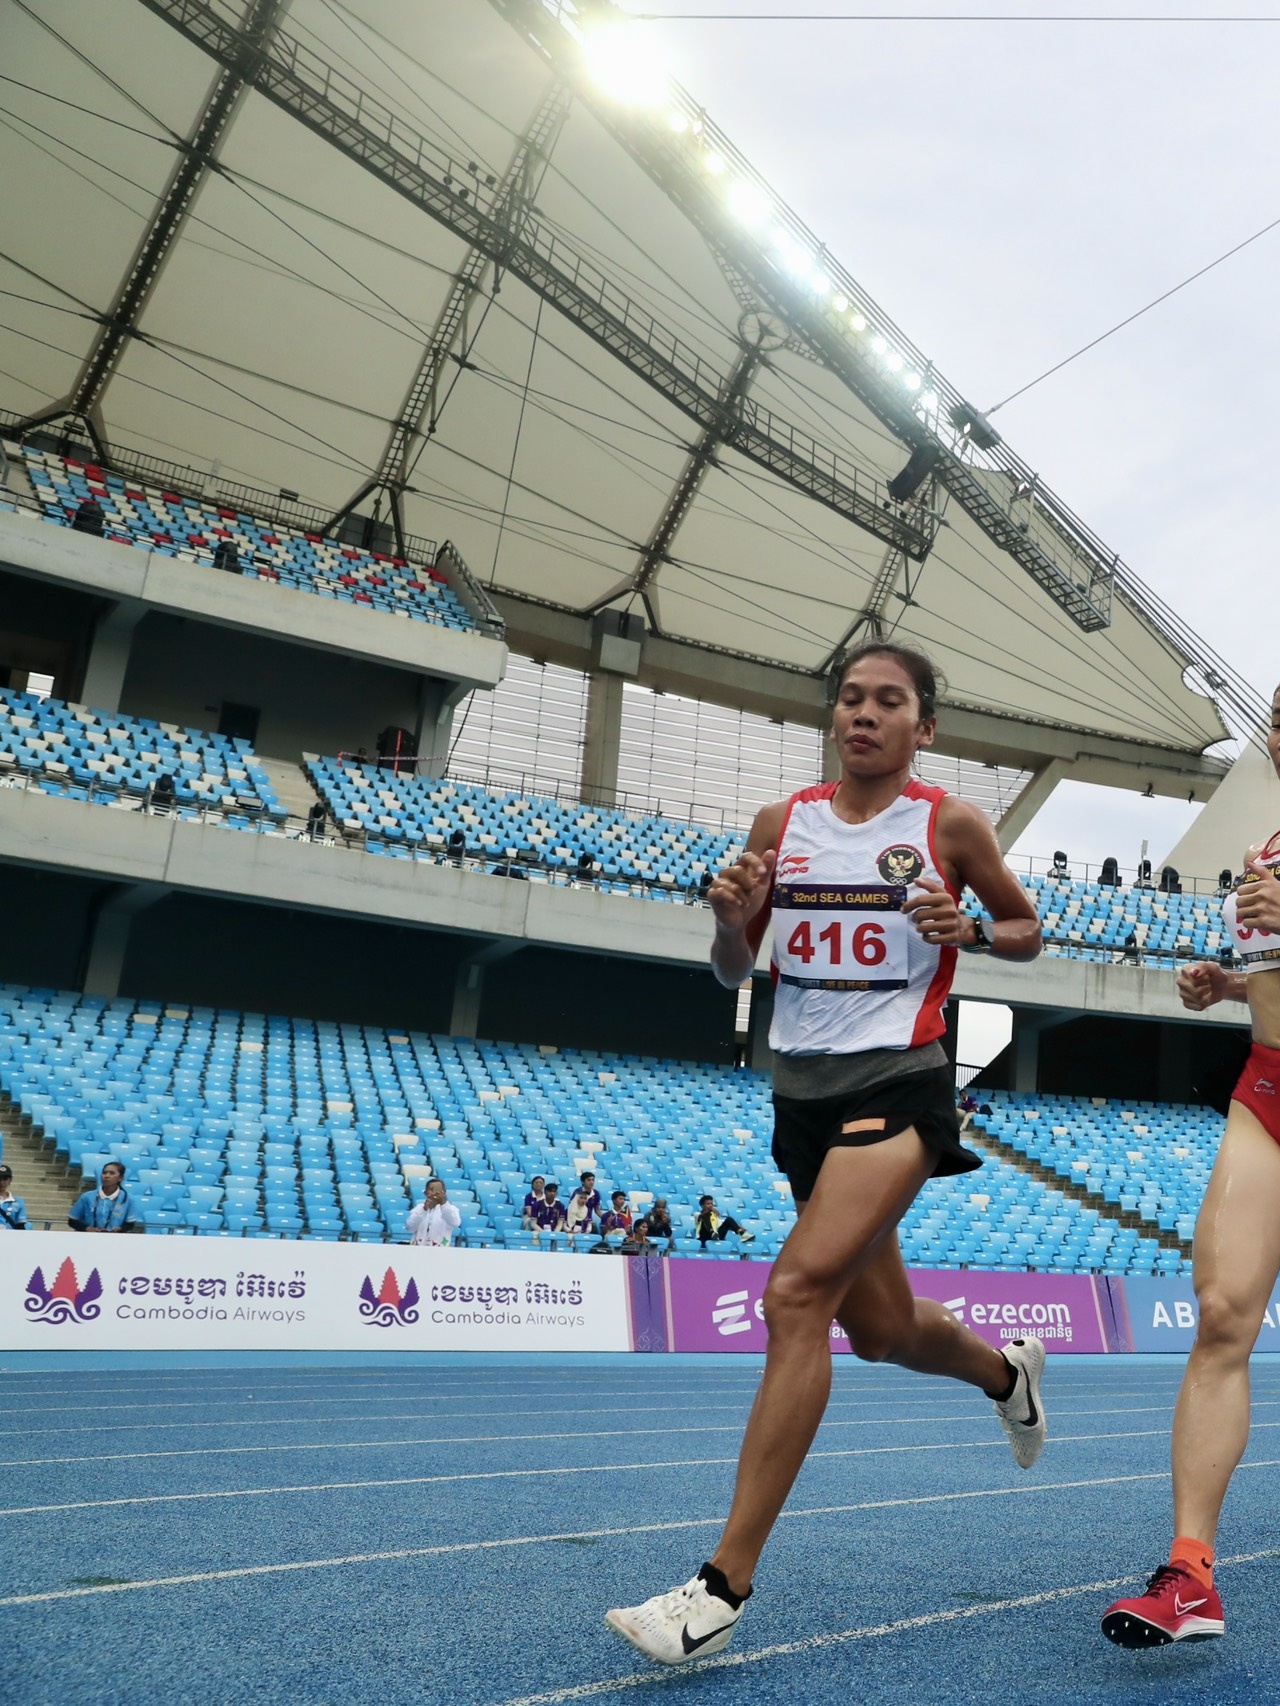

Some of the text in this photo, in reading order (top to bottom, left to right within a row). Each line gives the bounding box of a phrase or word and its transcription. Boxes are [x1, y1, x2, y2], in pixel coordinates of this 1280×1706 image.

[792, 892, 889, 904] 32nd SEA GAMES
[787, 920, 887, 966] 416
[116, 1304, 306, 1324] Cambodia Airways
[431, 1310, 585, 1328] Cambodia Airways
[970, 1303, 1071, 1324] ezecom
[1152, 1301, 1196, 1328] AB
